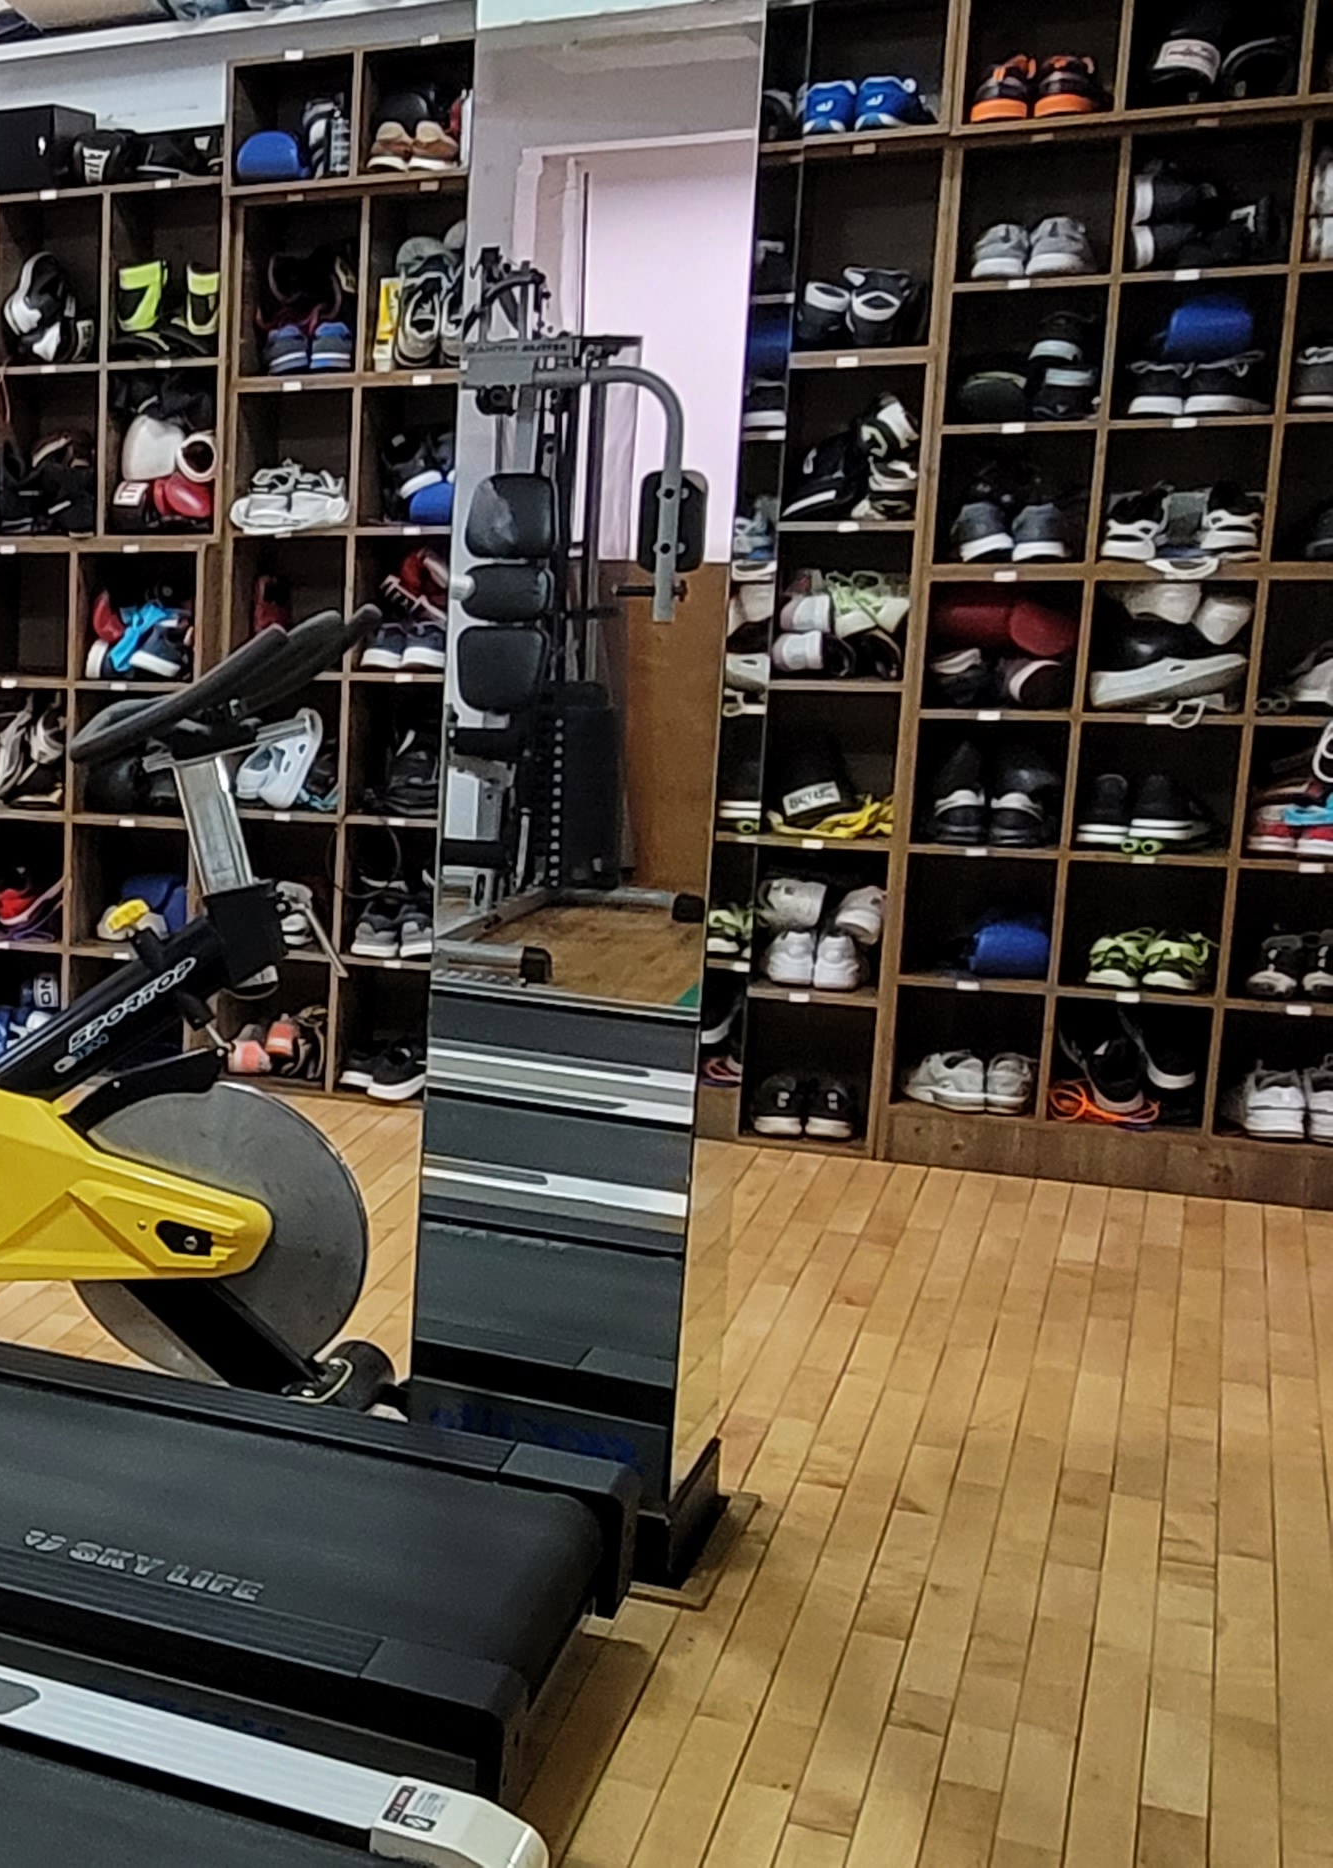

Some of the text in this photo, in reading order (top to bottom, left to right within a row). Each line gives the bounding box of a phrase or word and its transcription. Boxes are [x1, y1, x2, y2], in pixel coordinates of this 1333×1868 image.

[68, 956, 197, 1053] SPORTOP
[69, 1540, 264, 1602] SKY LIFE
